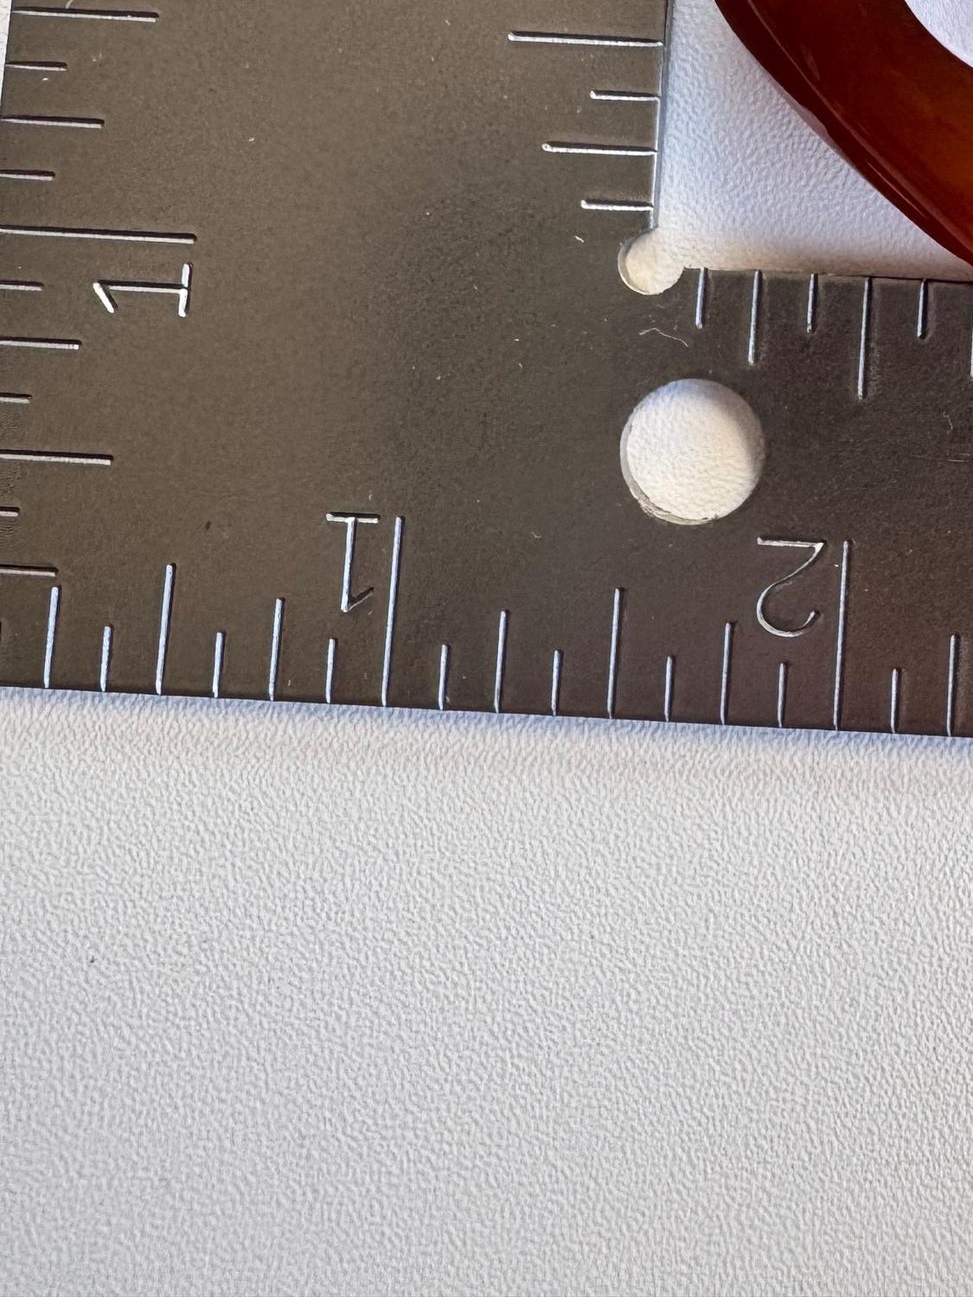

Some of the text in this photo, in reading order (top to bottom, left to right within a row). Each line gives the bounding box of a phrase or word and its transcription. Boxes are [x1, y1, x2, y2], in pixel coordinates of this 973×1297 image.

[91, 261, 194, 318] 1
[323, 511, 381, 613] 1
[755, 535, 826, 639] 2
